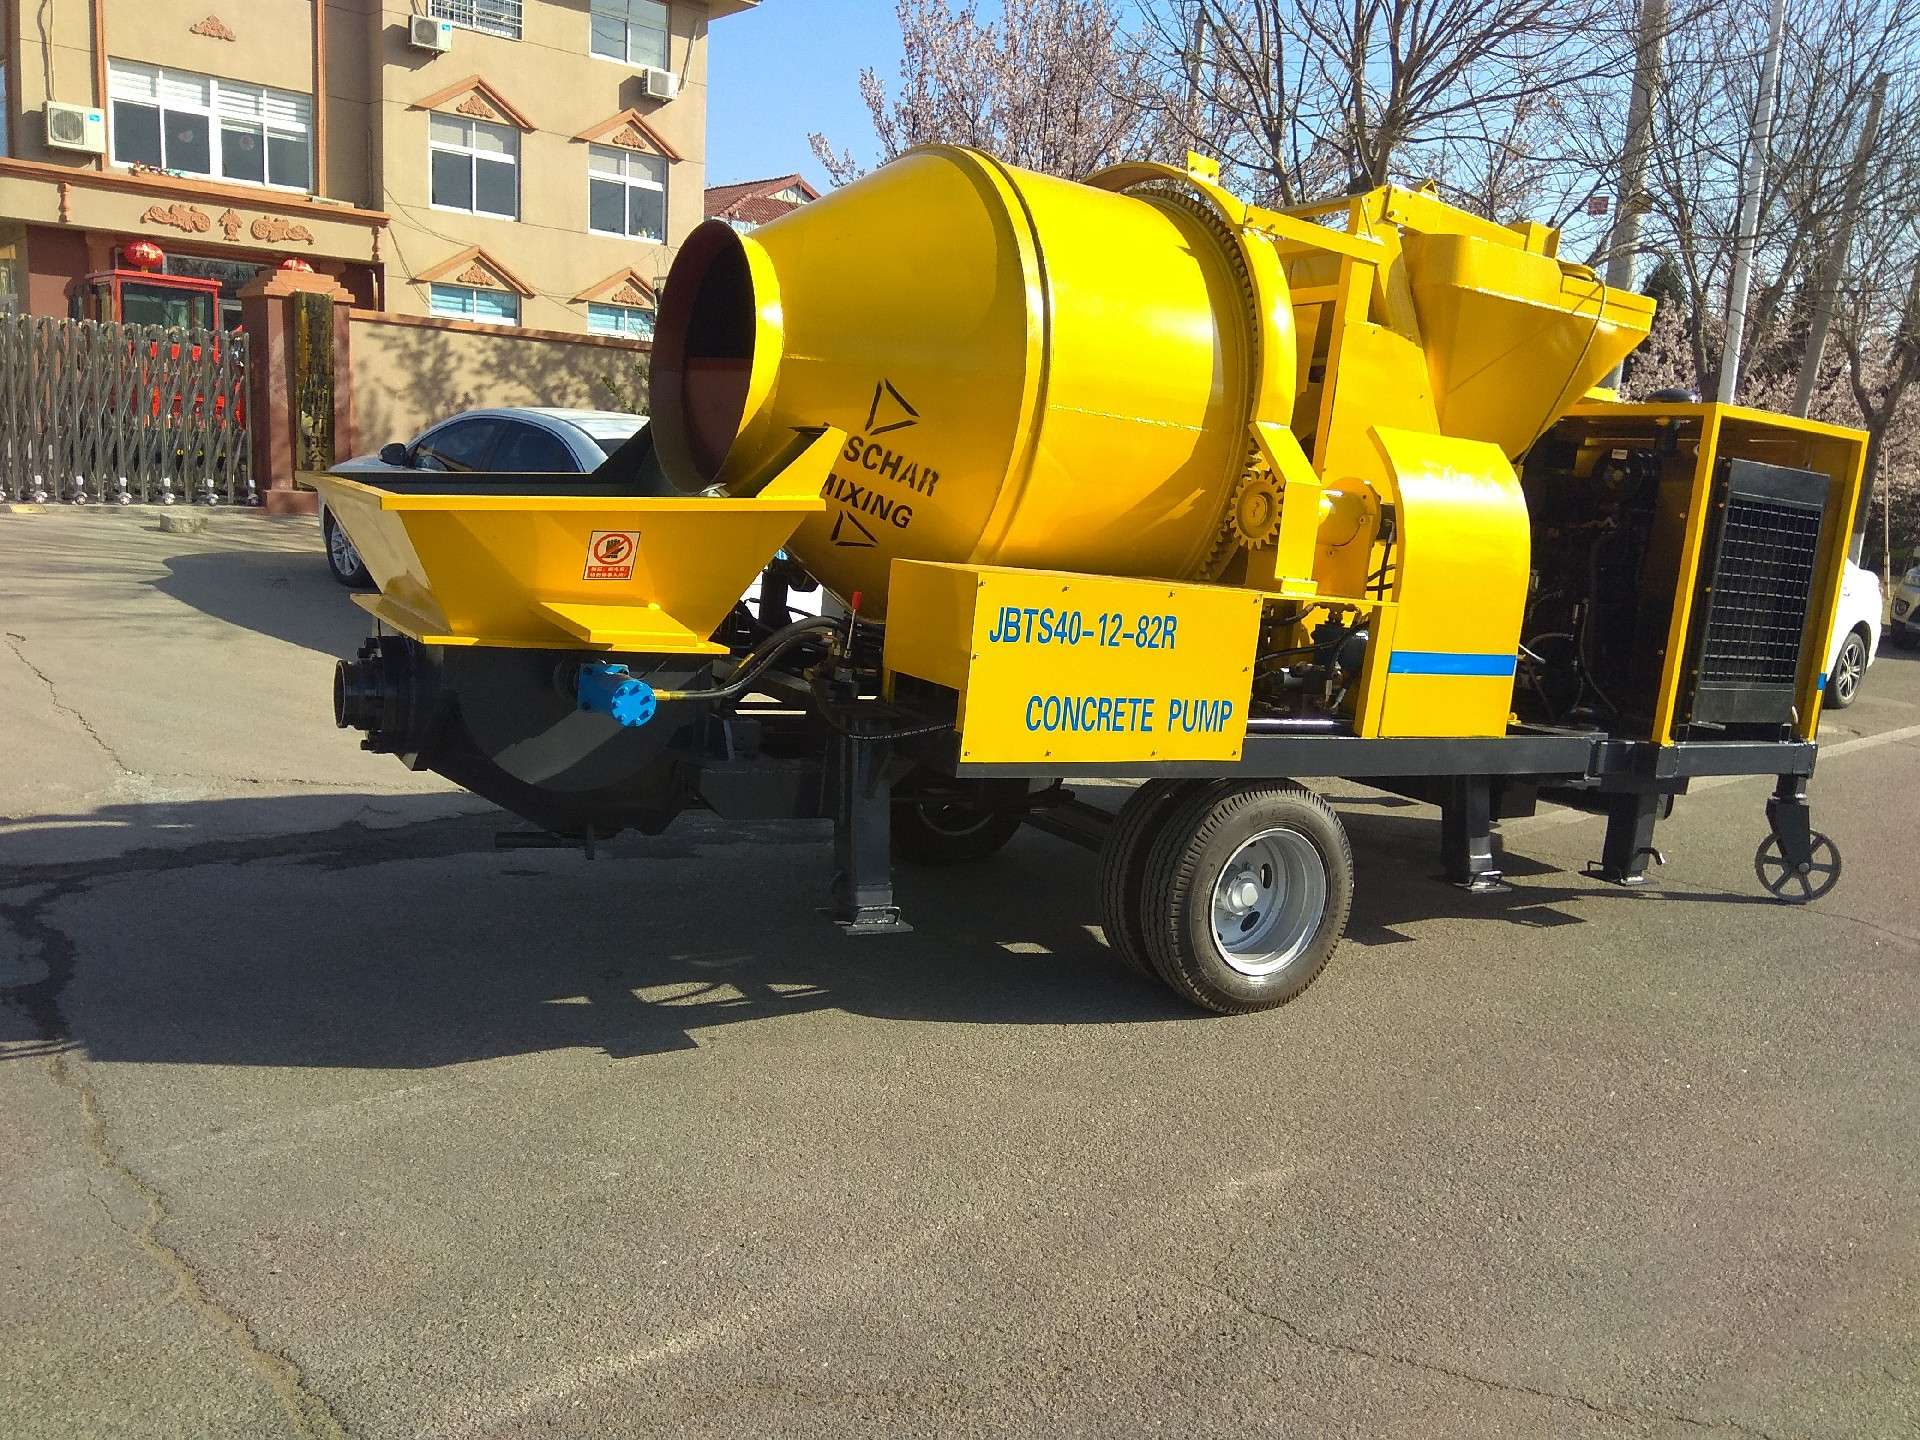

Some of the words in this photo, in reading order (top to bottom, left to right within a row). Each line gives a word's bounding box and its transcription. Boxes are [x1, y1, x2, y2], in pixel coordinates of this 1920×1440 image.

[989, 606, 1178, 649] JBTS40-12-82R
[1026, 695, 1155, 732] CONCRETE
[1168, 699, 1233, 732] PUMP
